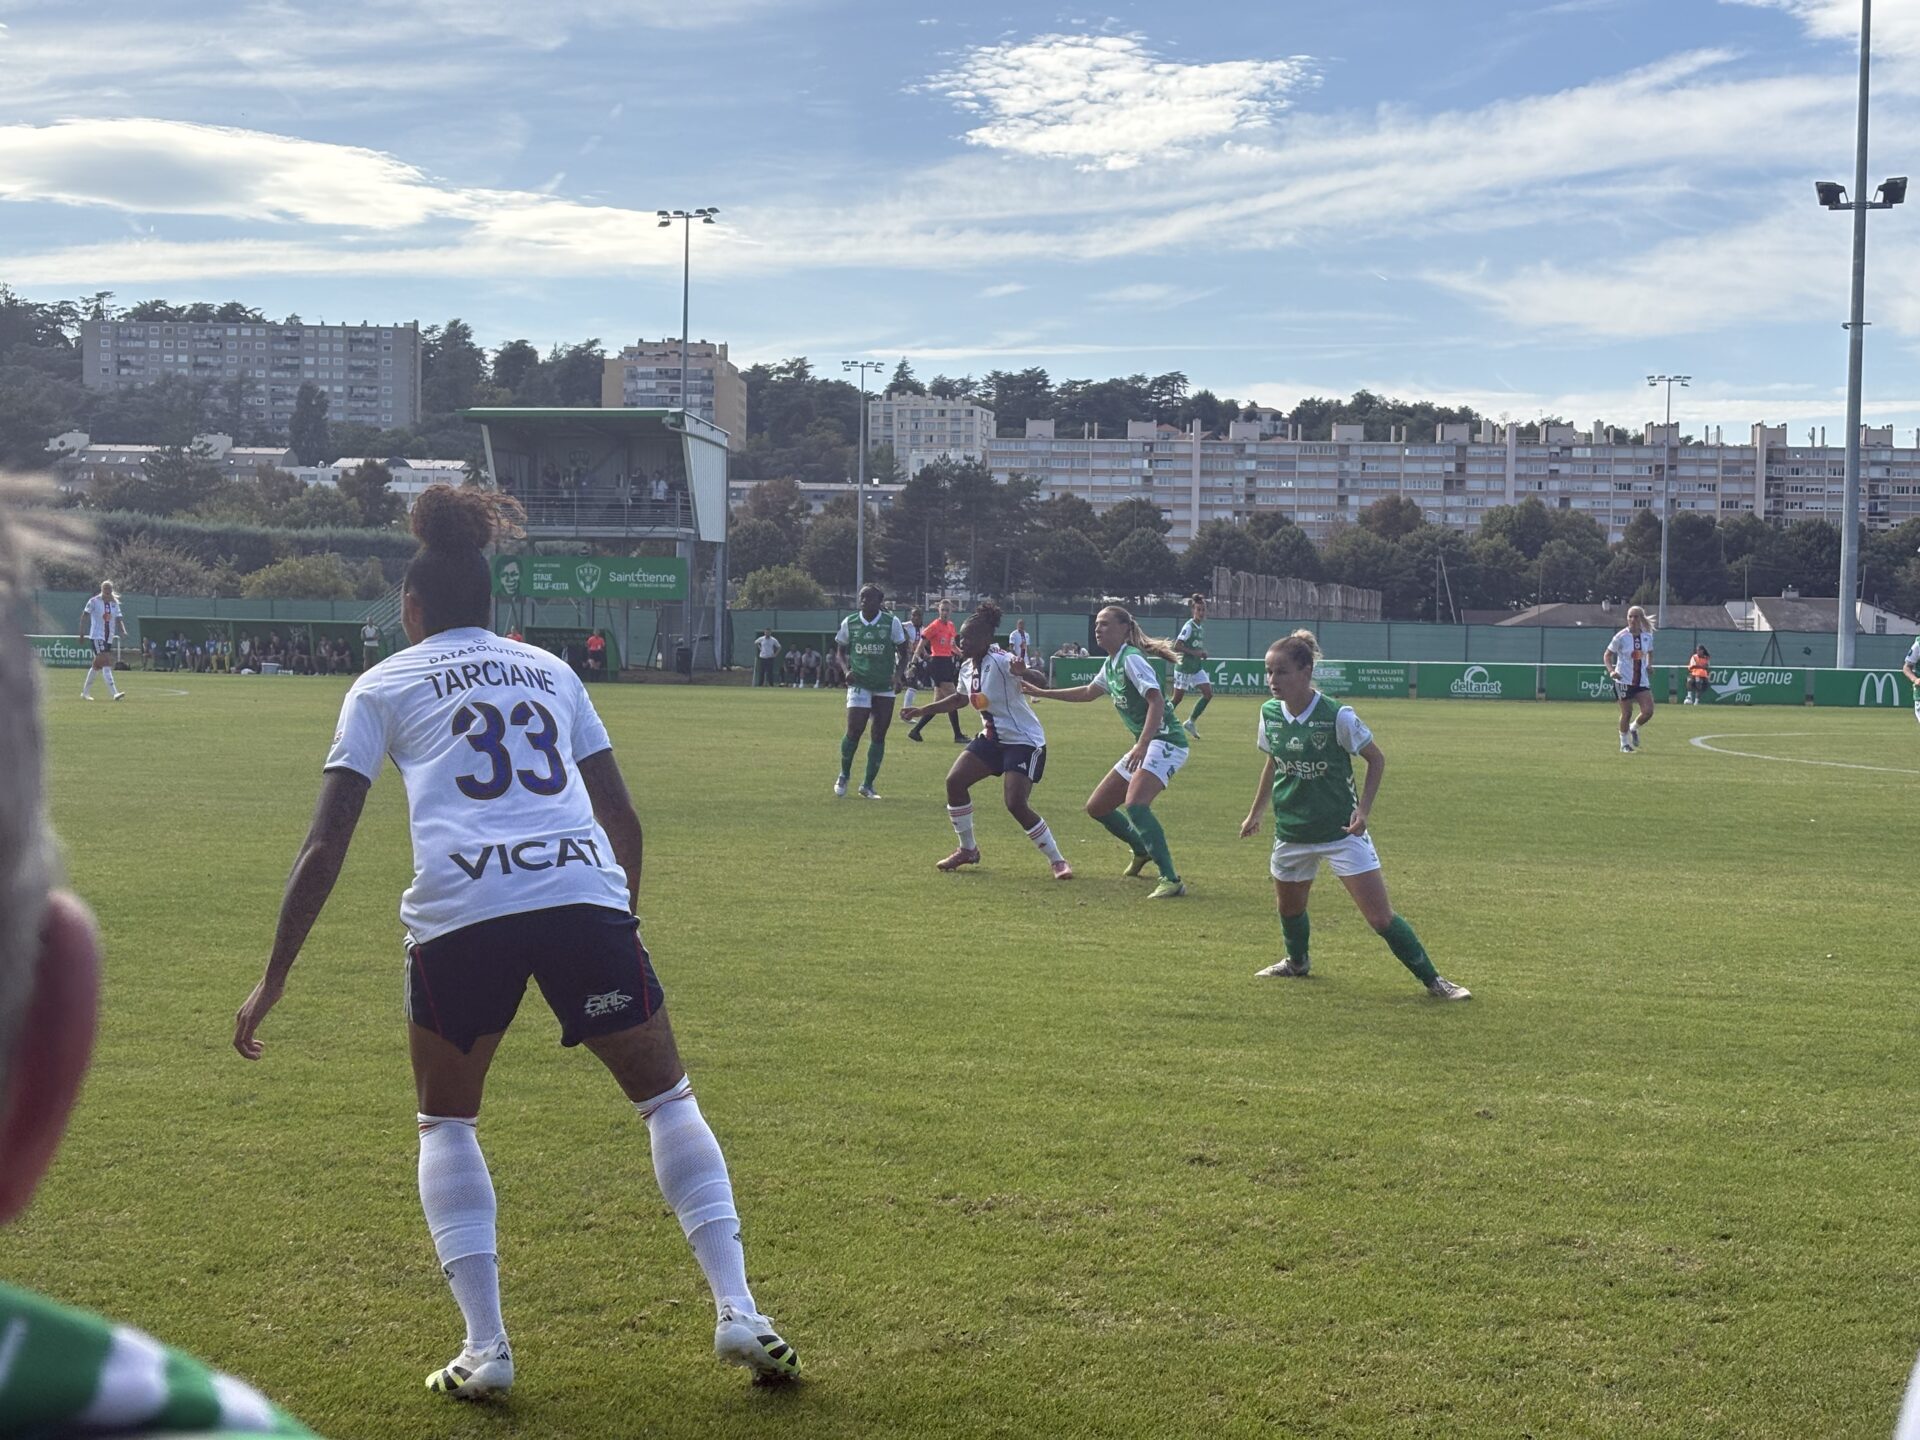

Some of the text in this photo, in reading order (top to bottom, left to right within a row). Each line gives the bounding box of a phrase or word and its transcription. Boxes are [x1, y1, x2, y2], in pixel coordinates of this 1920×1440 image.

[533, 573, 552, 581] STADE
[533, 582, 569, 590] SALIF-KEITA
[429, 645, 536, 664] DATASOLUTION
[425, 660, 557, 699] TARCIANE
[1708, 670, 1793, 685] ort avenue
[1450, 679, 1502, 694] deltanet
[1735, 693, 1751, 702] pro
[451, 700, 567, 801] 33
[448, 838, 603, 881] VICAT
